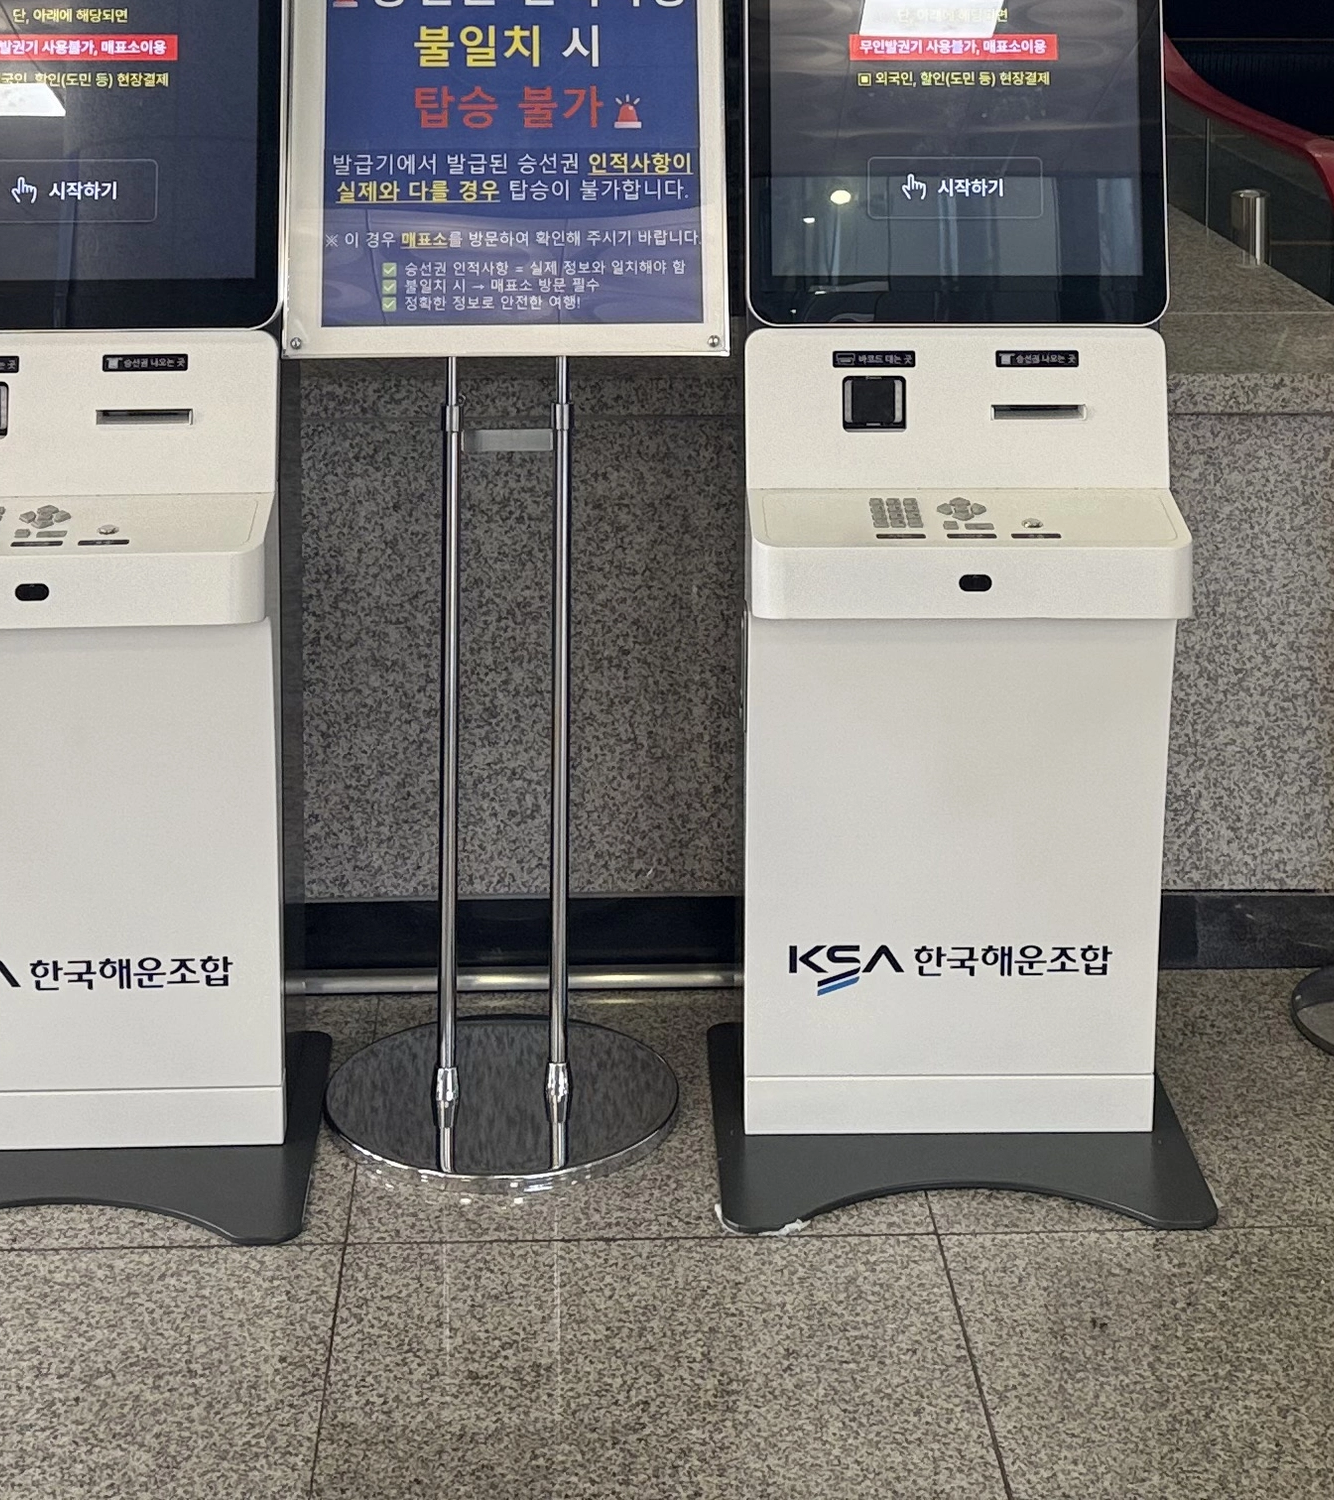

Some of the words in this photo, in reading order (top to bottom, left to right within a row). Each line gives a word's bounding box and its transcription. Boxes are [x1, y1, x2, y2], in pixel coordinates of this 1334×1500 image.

[13, 9, 28, 24] 단,
[33, 9, 72, 23] 아래에
[76, 9, 127, 23] 해당되면
[42, 40, 98, 56] 사용불가,
[101, 40, 167, 55] 매표소이용
[414, 25, 540, 68] 불일치
[562, 25, 599, 67] 시
[859, 39, 923, 54] 무인발권기
[926, 40, 981, 56] 사용불가,
[983, 40, 1047, 54] 매표소이용
[96, 73, 113, 88] 등)
[117, 73, 168, 87] 현장결제
[875, 72, 916, 87] 외국인,
[920, 72, 975, 87] 할인(도민
[979, 72, 995, 87] 등)
[999, 71, 1050, 86] 현장결제
[414, 85, 498, 129] 탑승
[518, 85, 604, 129] 불가
[334, 154, 436, 175] 발급기에서
[448, 154, 507, 175] 발급된
[518, 153, 578, 174] 승선권
[589, 153, 691, 174] 인적사항이
[48, 180, 118, 200] 시작하기
[337, 180, 400, 202] 실제와
[409, 180, 449, 202] 다를
[459, 180, 499, 201] 경우
[510, 179, 569, 201] 탑승이
[580, 179, 689, 201] 불가합니다.
[937, 178, 1004, 198] 시작하기
[366, 232, 396, 248] 경우
[401, 231, 462, 248] 매표소를
[469, 231, 529, 247] 방문하여
[536, 231, 581, 246] 확인해
[587, 230, 632, 246] 주시기
[638, 230, 702, 246] 바랍니다.
[405, 262, 447, 276] 승선권
[453, 262, 508, 276] 인적사항
[531, 260, 557, 275] 실제
[563, 260, 605, 275] 정보와
[611, 260, 667, 275] 일치해야
[673, 260, 685, 275] 함
[405, 280, 447, 294] 불일치
[453, 279, 465, 293] 시
[491, 279, 532, 293] 매표소
[538, 278, 566, 292] 방문
[572, 278, 599, 292] 필수
[405, 296, 447, 311] 정확한
[453, 297, 495, 310] 정보로
[501, 296, 542, 310] 안전한
[549, 295, 580, 309] 여행!
[29, 956, 233, 991] 한국해운조합
[789, 944, 905, 997] KSA
[914, 944, 1113, 976] 한국해운조합
